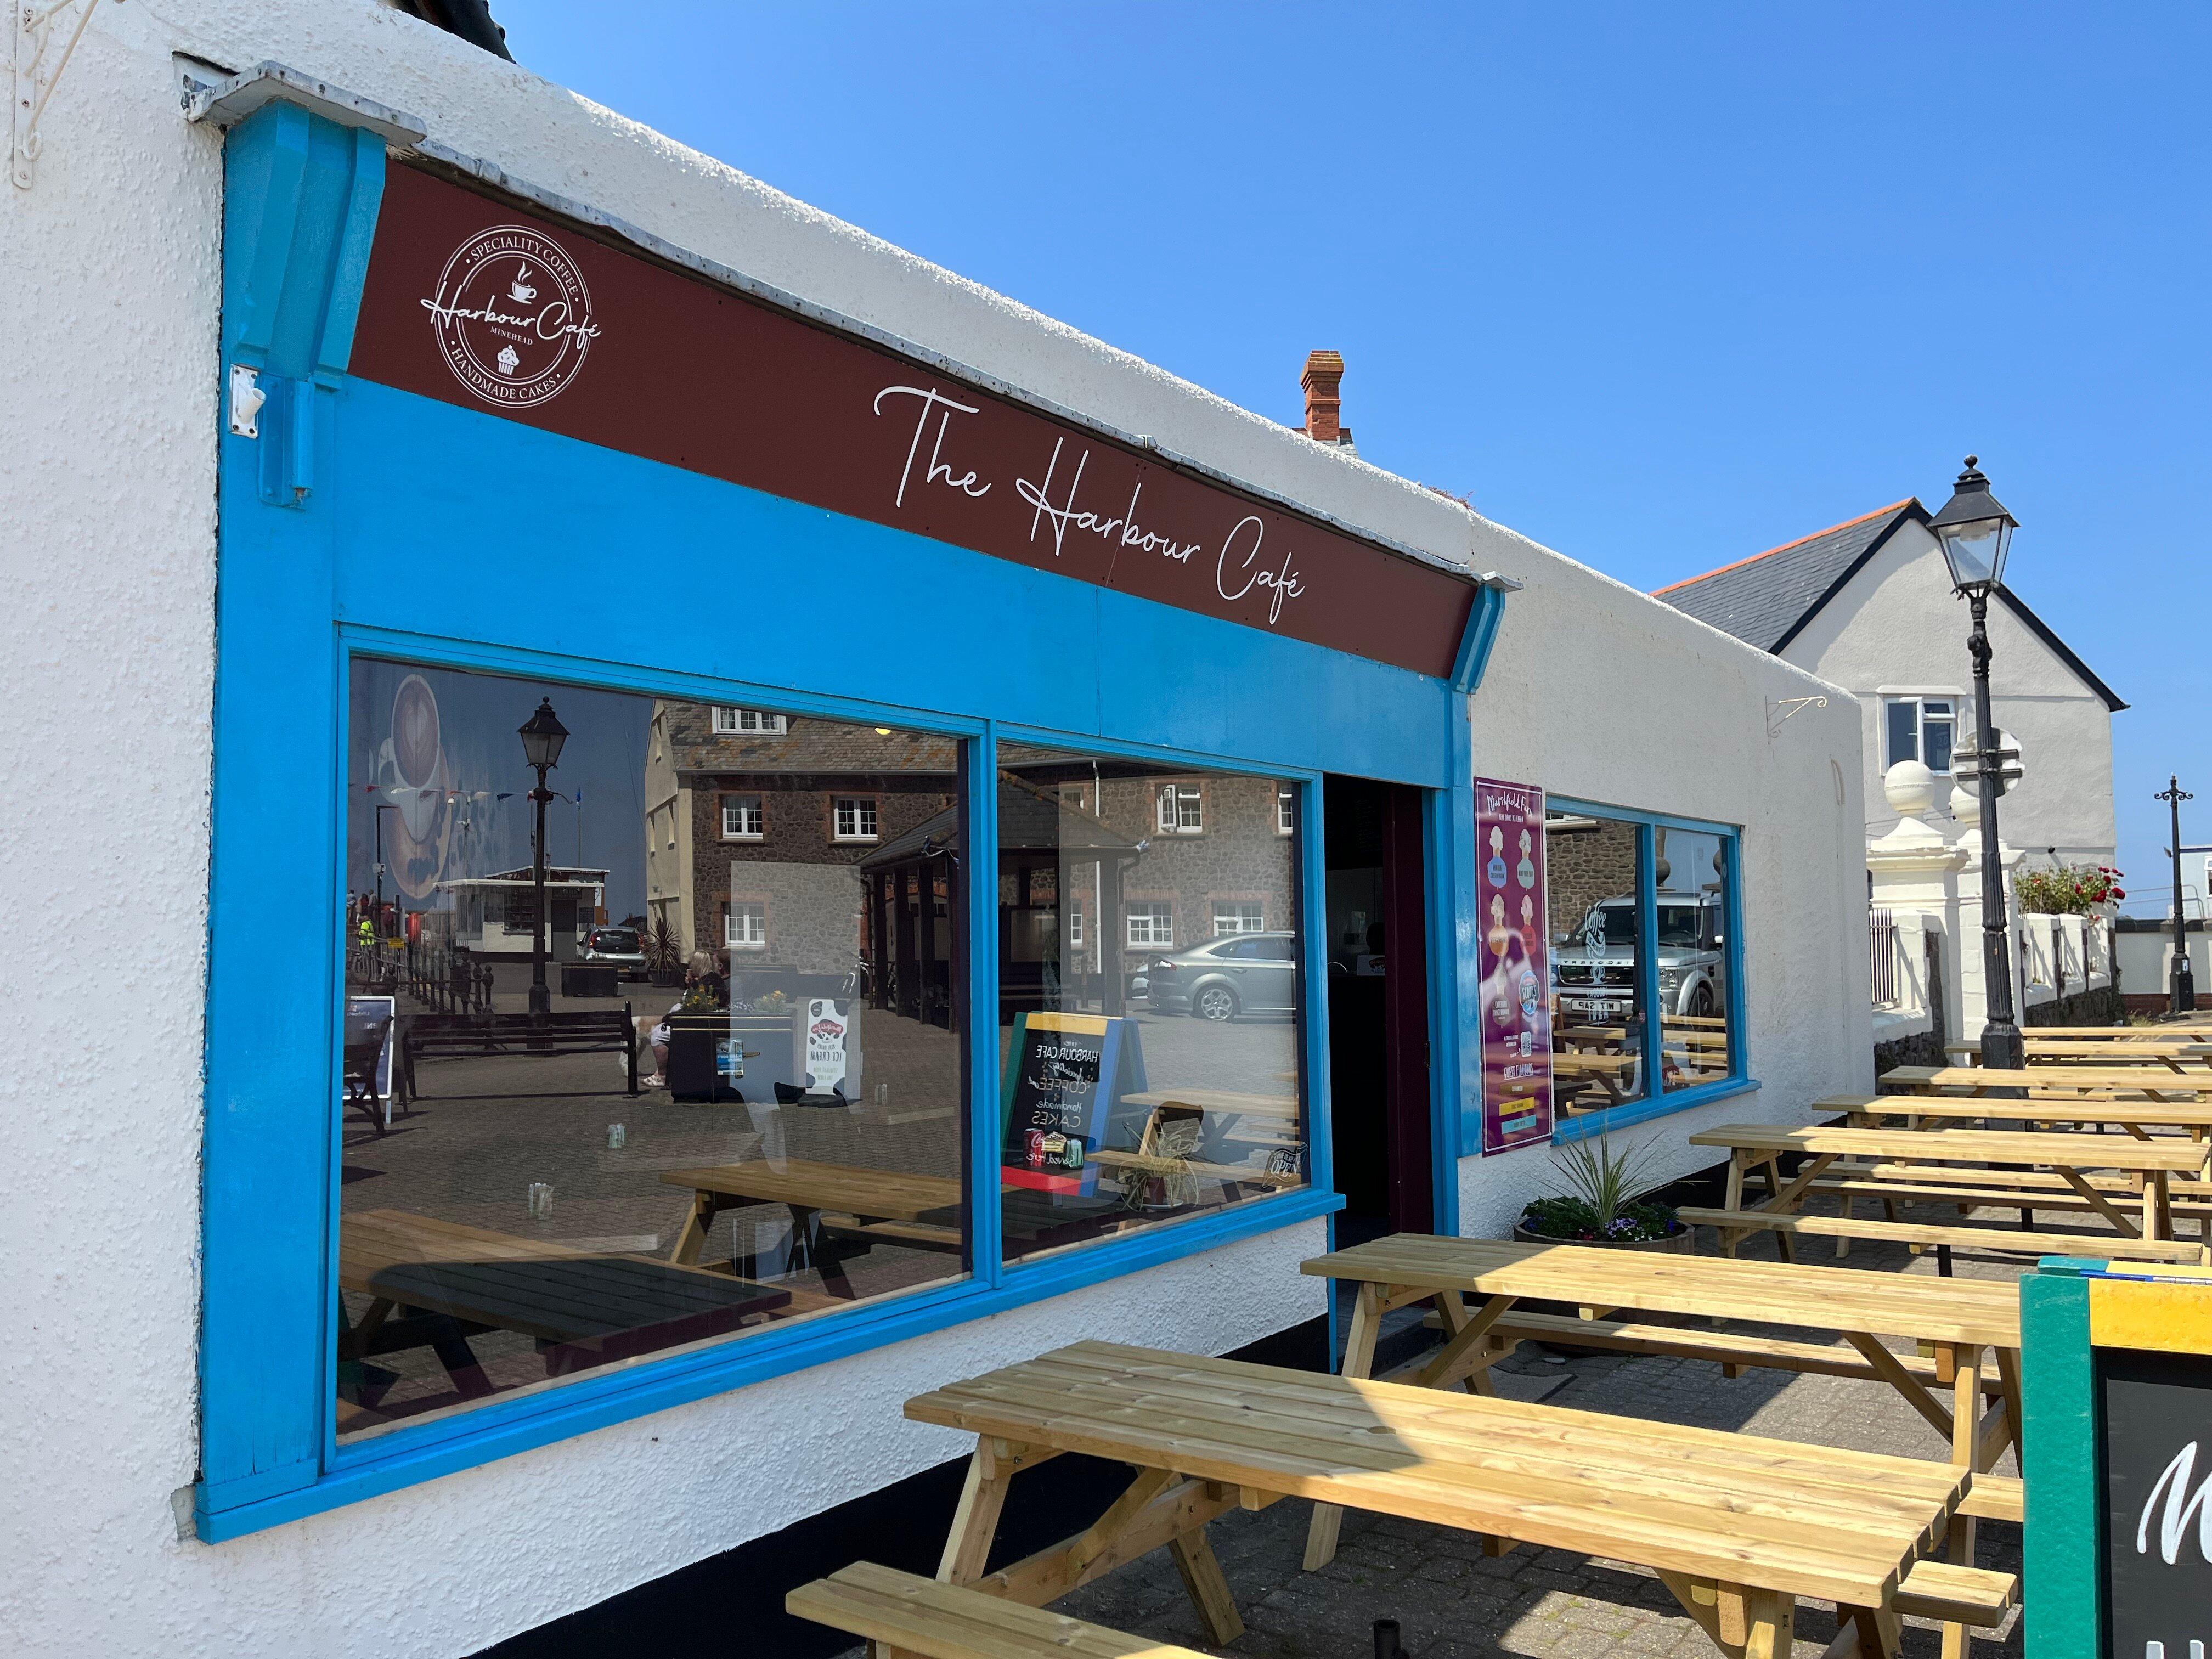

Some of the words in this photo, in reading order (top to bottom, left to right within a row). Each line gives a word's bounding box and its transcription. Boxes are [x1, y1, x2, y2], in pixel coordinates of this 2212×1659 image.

[471, 236, 543, 262] SPECIALITY
[543, 249, 578, 295] COFFEE
[420, 280, 537, 330] Harbour
[536, 301, 602, 350] Café
[490, 326, 533, 346] MINEHEAD
[452, 347, 517, 399] HANDMADE
[518, 376, 557, 399] CAKES
[873, 386, 992, 507] The
[1015, 436, 1200, 565] Harbour
[1216, 516, 1305, 625] Café
[1585, 905, 1606, 936] Coffee
[1504, 1066, 1515, 1079] GUEST
[1271, 1159, 1297, 1178] OPEN
